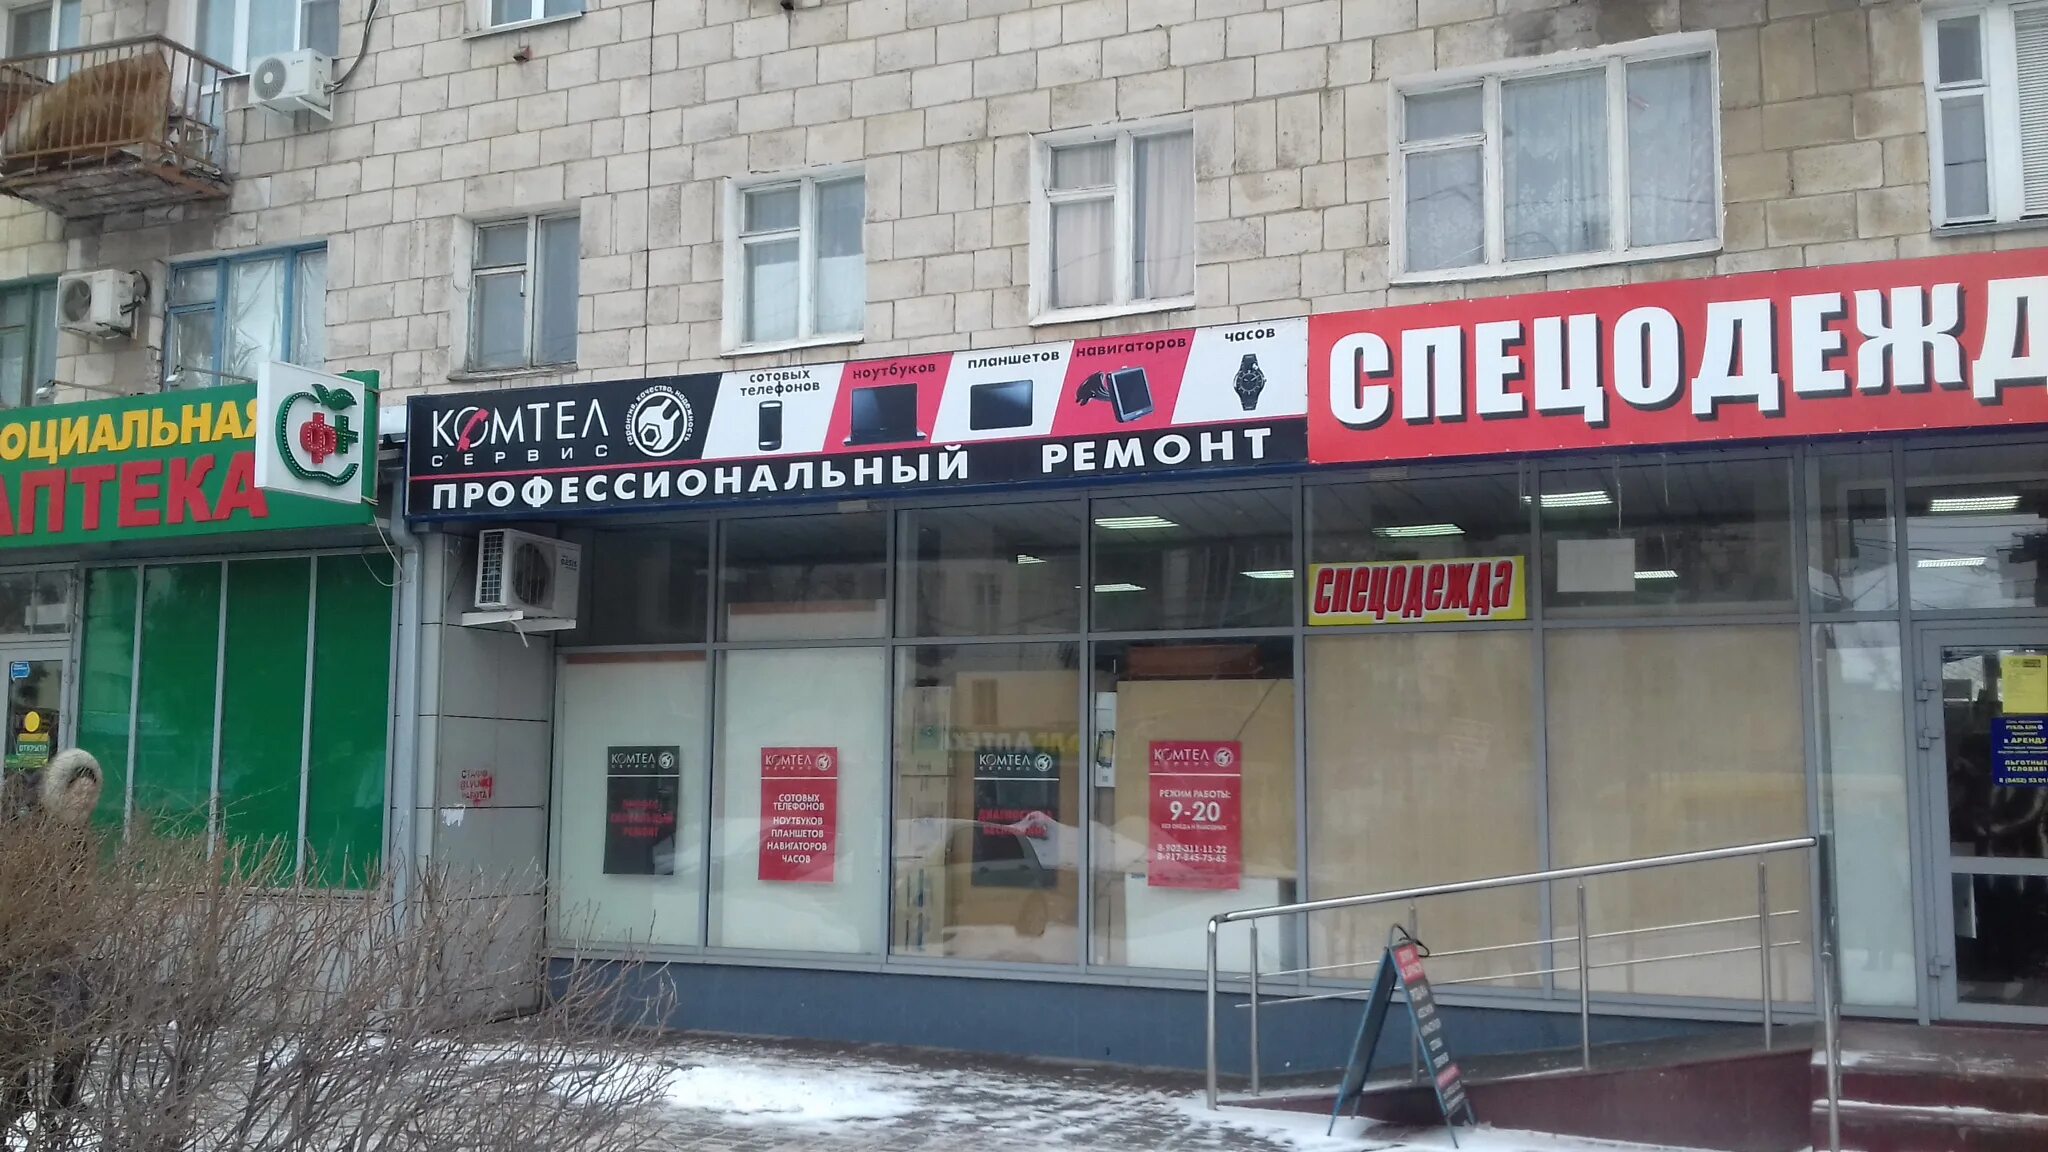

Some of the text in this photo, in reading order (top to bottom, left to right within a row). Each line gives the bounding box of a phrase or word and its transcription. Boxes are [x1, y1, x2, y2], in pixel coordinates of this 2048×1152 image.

[1224, 326, 1276, 342] часов
[1076, 337, 1187, 357] навигаторов
[968, 351, 1060, 369] планшетов
[749, 369, 810, 383] сотовых
[853, 362, 936, 380] ноутбуков
[740, 381, 820, 397] телефонов
[432, 399, 609, 449] КОМТЕЛ
[431, 445, 609, 467] СЕРВИС
[432, 428, 1272, 510] ПРОФЕССИОНАЛЬНЫЙ РЕМОНТ
[0, 451, 269, 537] ПТЕКА
[778, 794, 820, 803] СОТОВЫХ
[1159, 789, 1231, 799] РЕЖИМ РАБОТЫ:
[773, 802, 825, 811] ТЕЛЕФОНОВ
[1169, 800, 1221, 821] 9-20
[773, 817, 823, 825] НОУТБУКОВ
[771, 829, 824, 838] ПЛАНШЕТОВ
[767, 842, 827, 851] НАВИГАТОРОВ
[782, 855, 811, 863] ЧАСОВ
